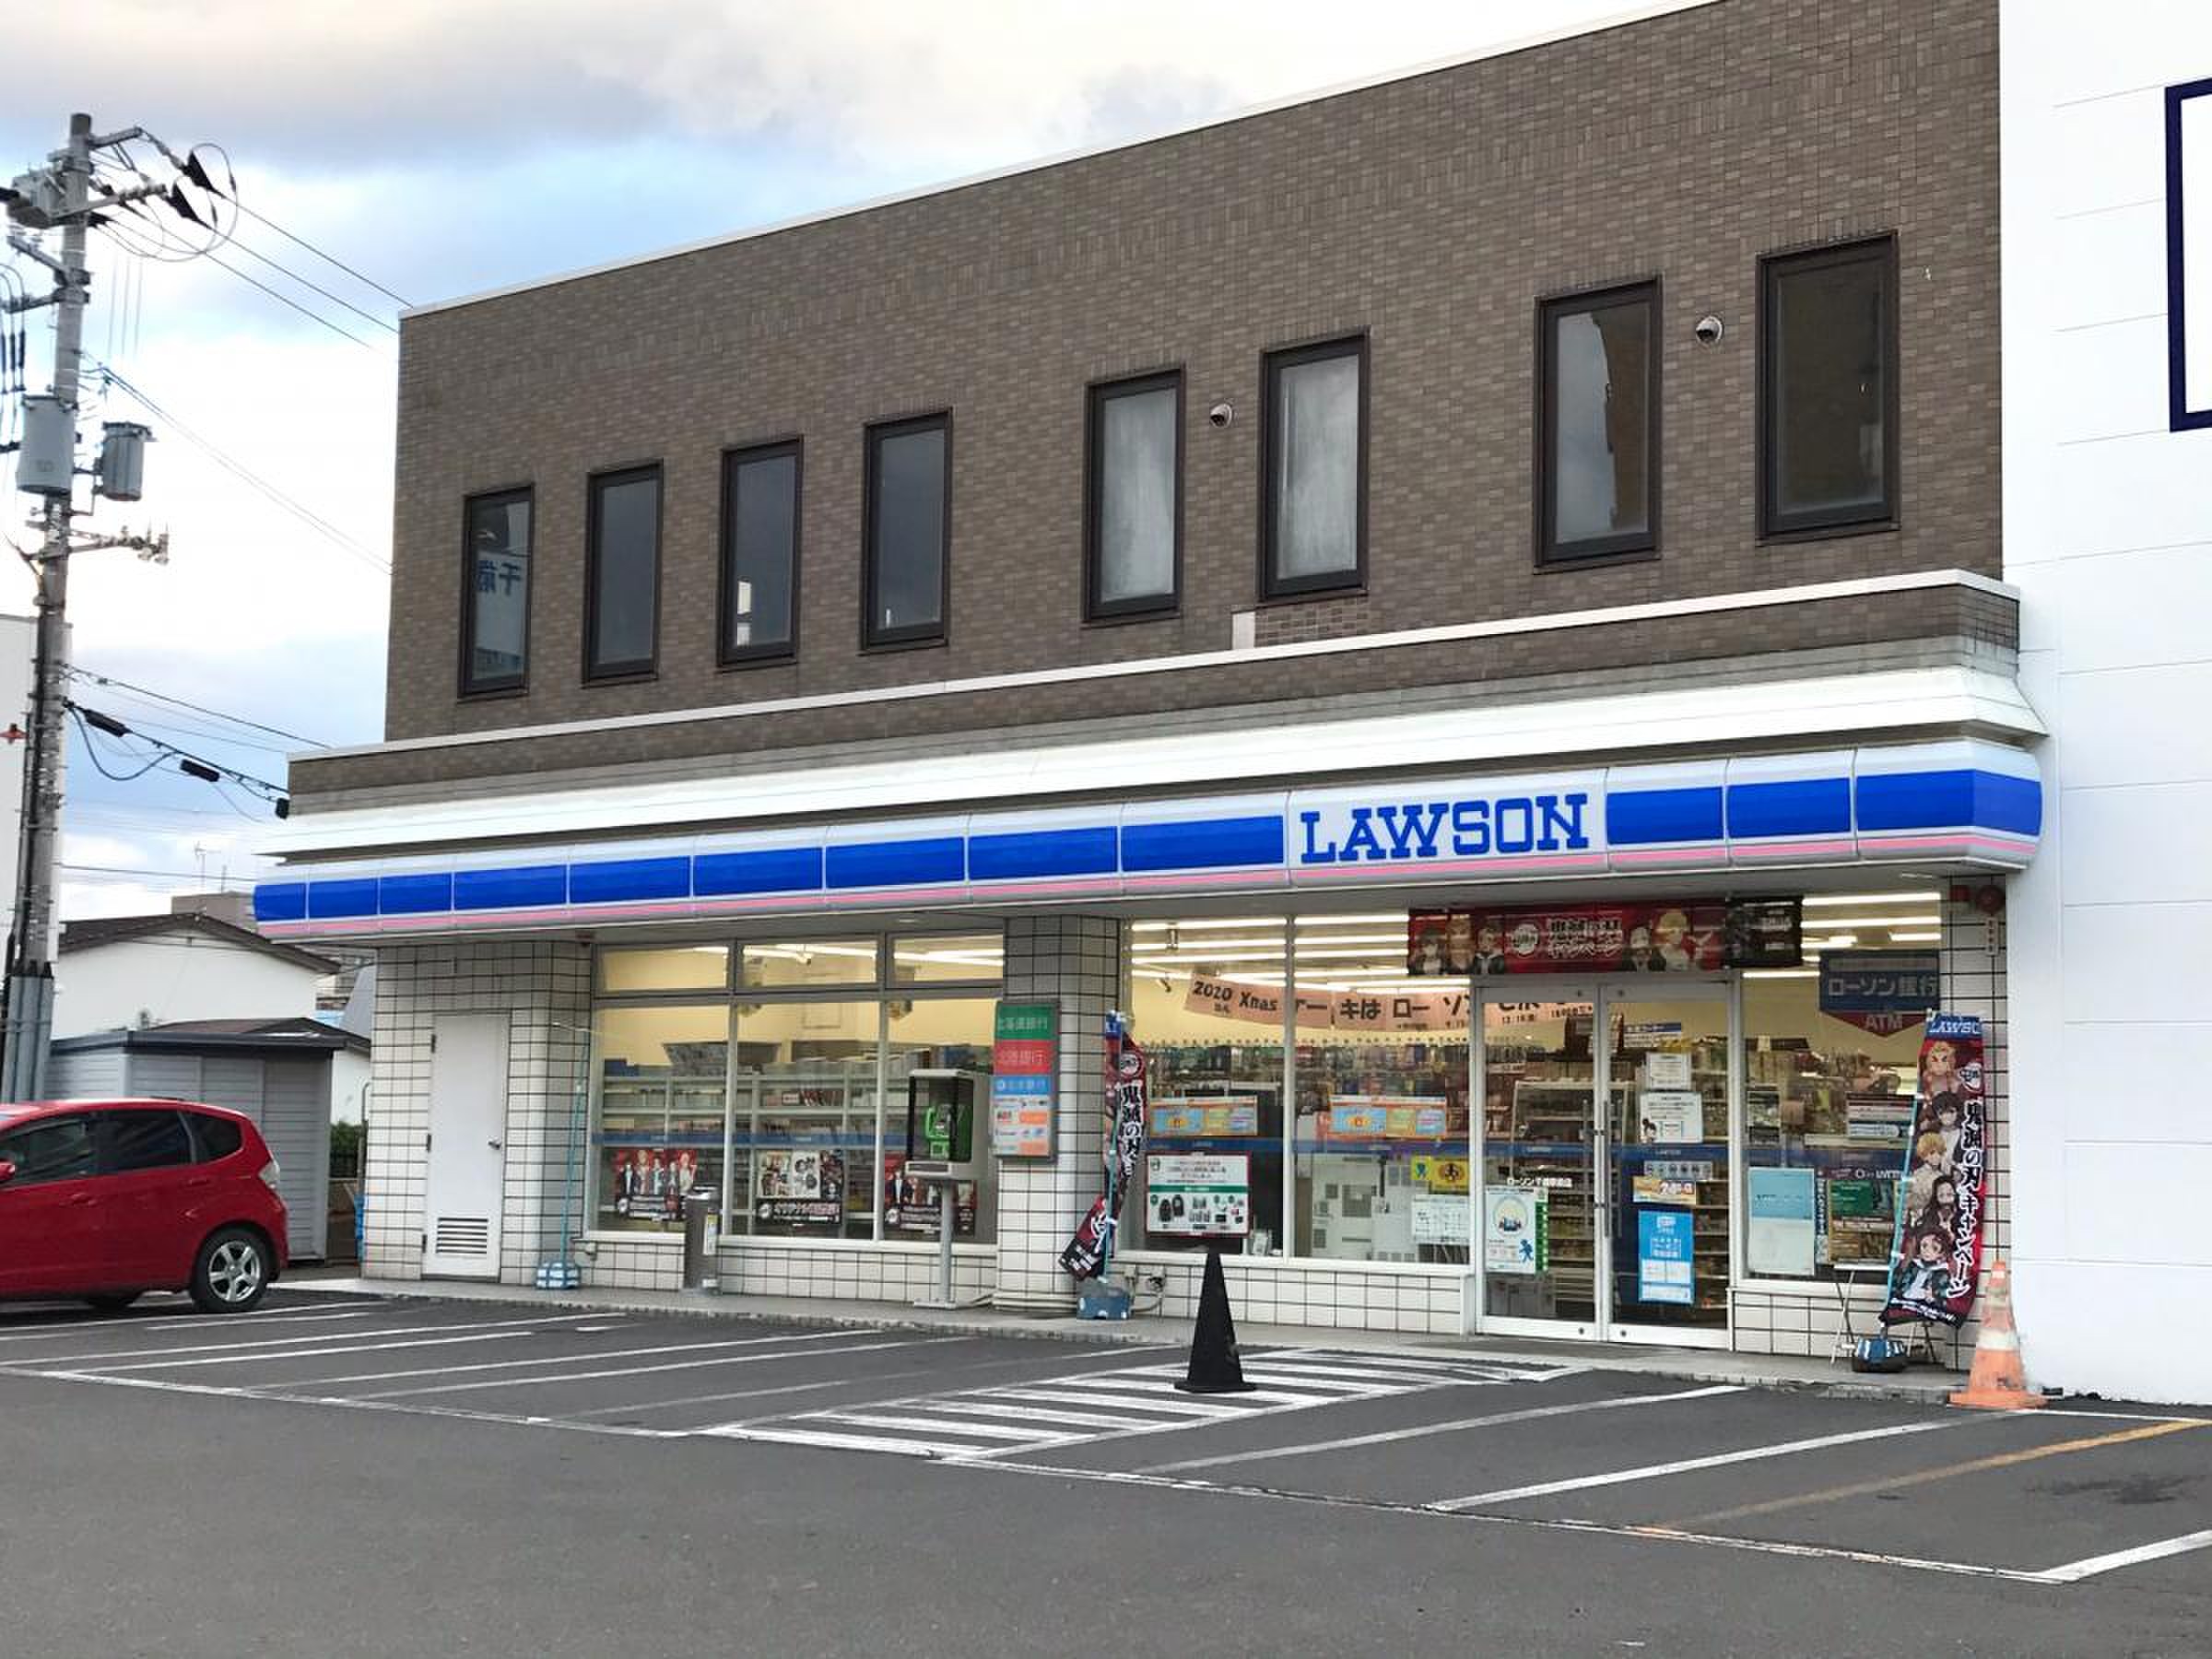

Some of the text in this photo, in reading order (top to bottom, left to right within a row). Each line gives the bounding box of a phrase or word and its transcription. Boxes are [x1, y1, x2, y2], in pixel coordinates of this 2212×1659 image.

[1300, 793, 1589, 864] LAWSON
[1192, 981, 1233, 1002] 2020
[1865, 1014, 1903, 1030] ATM
